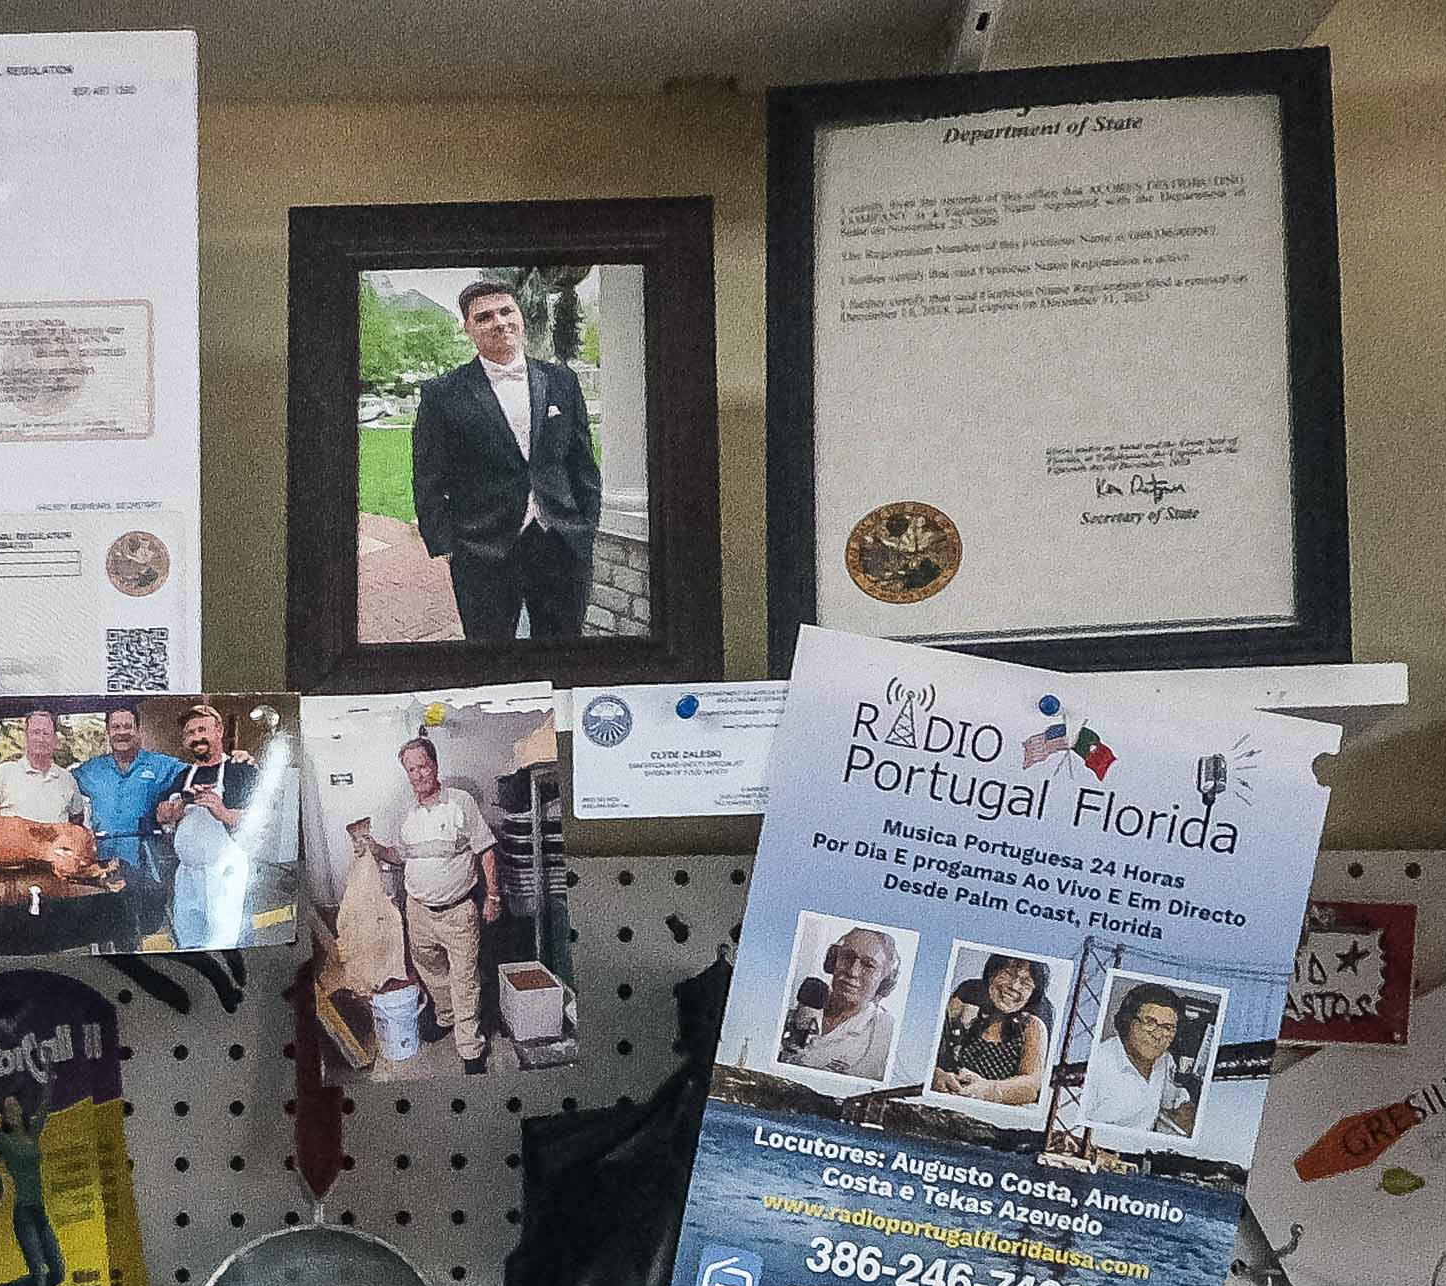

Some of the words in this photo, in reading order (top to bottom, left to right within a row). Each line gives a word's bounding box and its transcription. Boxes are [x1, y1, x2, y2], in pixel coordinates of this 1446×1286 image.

[942, 122, 1060, 145] Department
[1067, 117, 1090, 136] of
[1091, 116, 1144, 132] State
[842, 743, 1051, 821] Portugal
[1073, 786, 1239, 855] Florida
[812, 832, 849, 853] Por
[854, 840, 888, 862] Dia
[894, 848, 908, 865] E
[913, 854, 1017, 887] progamas
[1022, 872, 1050, 891] Ao
[1056, 877, 1102, 902] Vivo
[1107, 887, 1123, 905] E
[1127, 892, 1162, 913] Em
[1167, 898, 1247, 927] Directo
[882, 818, 957, 848] Musica
[963, 834, 1084, 872] Portuguesa
[1089, 857, 1116, 877] 24
[1122, 862, 1186, 890] Horas
[883, 873, 949, 900] Desde
[954, 886, 1009, 912] Palm
[1015, 899, 1082, 928] Coast,
[1088, 911, 1164, 941] Florida
[753, 1125, 886, 1168] Locutores:
[890, 1151, 995, 1189] Augusto
[1001, 1173, 1079, 1207] Costa,
[1084, 1186, 1185, 1224] Antonio
[822, 1167, 893, 1199] Costa
[900, 1183, 916, 1200] e
[922, 1183, 993, 1218] Tekas
[998, 1201, 1103, 1237] Azevedo
[763, 1193, 1150, 1279] www.radioportugalfloridausa.com
